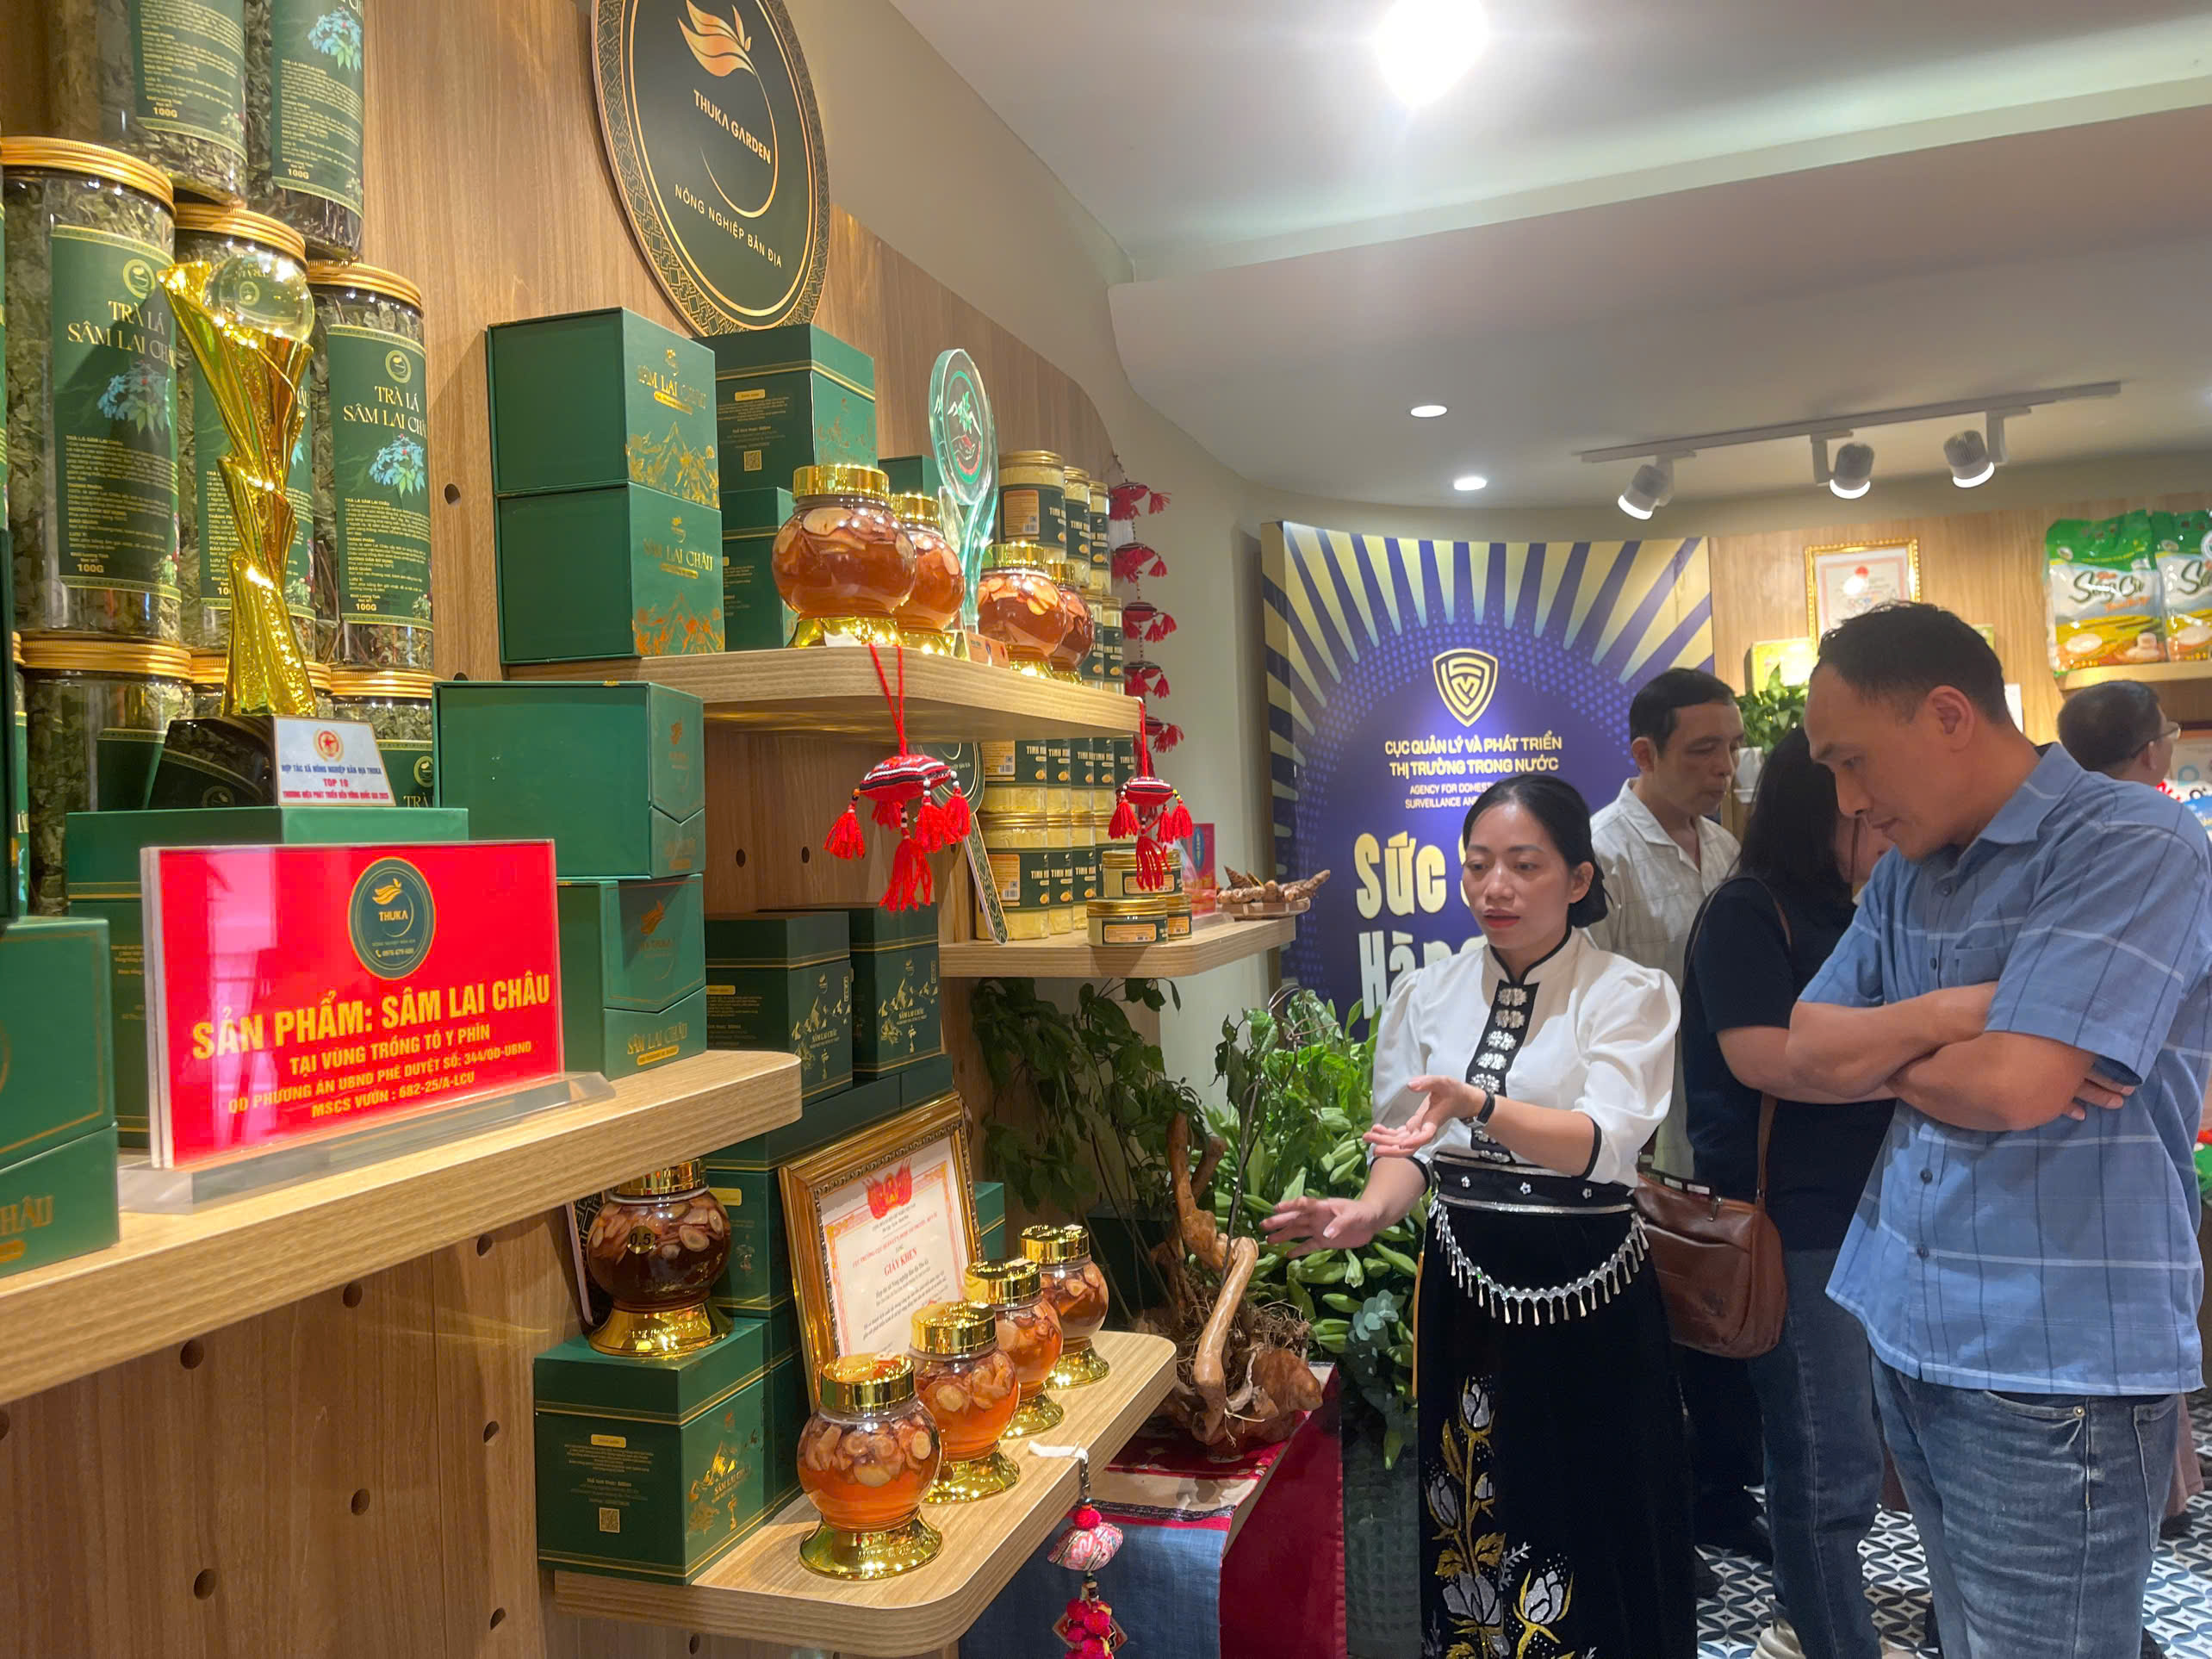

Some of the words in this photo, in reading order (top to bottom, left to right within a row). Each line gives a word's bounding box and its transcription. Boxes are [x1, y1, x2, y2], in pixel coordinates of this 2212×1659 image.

[693, 90, 729, 131] THUKA
[730, 120, 771, 165] GARDEN
[674, 184, 705, 214] NÔNG
[708, 207, 744, 239] NGHIỆP
[747, 233, 765, 256] BẢN
[767, 251, 782, 268] ĐỊA
[109, 301, 144, 326] TRÀ
[148, 311, 165, 335] LÁ
[68, 320, 111, 346] SÂM
[118, 330, 145, 354] LAI
[661, 375, 677, 396] LAI
[375, 386, 403, 407] TRÀ
[406, 393, 419, 413] LÁ
[344, 403, 378, 424] SÂM
[382, 410, 405, 429] LAI
[77, 563, 104, 573] 100G
[686, 551, 713, 572] CHÂU
[1385, 739, 1410, 759] CỤC
[1411, 734, 1447, 755] QUẢN
[1448, 735, 1464, 754] LÝ
[1464, 734, 1482, 753] VÀ
[1484, 733, 1518, 752] PHÁT
[1519, 730, 1563, 751] TRIỂN
[1389, 761, 1410, 780] THỊ
[1410, 756, 1466, 777] TRƯỜNG
[1467, 759, 1513, 774] TRONG
[1514, 754, 1559, 773] NƯỚC
[403, 792, 429, 807] TRÀ
[1410, 784, 1440, 796] AGENCY
[1441, 783, 1457, 794] FOR
[1458, 781, 1495, 793] DOMEST
[1405, 796, 1461, 810] SURVEILLANCE
[1354, 830, 1447, 919] Sức
[379, 910, 408, 922] THUKA
[192, 1005, 264, 1059] SẢN
[275, 990, 373, 1047] PHẨM:
[382, 986, 441, 1029] SÂM
[449, 983, 485, 1018] LAI
[492, 970, 550, 1011] CHÂU
[289, 1054, 317, 1078] TẠI
[445, 1029, 454, 1047] Y
[252, 1084, 312, 1109] PHƯƠNG
[315, 1078, 335, 1096] ÁN
[339, 1072, 374, 1091] UBND
[404, 1058, 440, 1078] DUYỆT
[311, 1098, 351, 1119] MSCS
[0, 1195, 54, 1236] HÂU
[900, 1247, 917, 1266] KHEN
